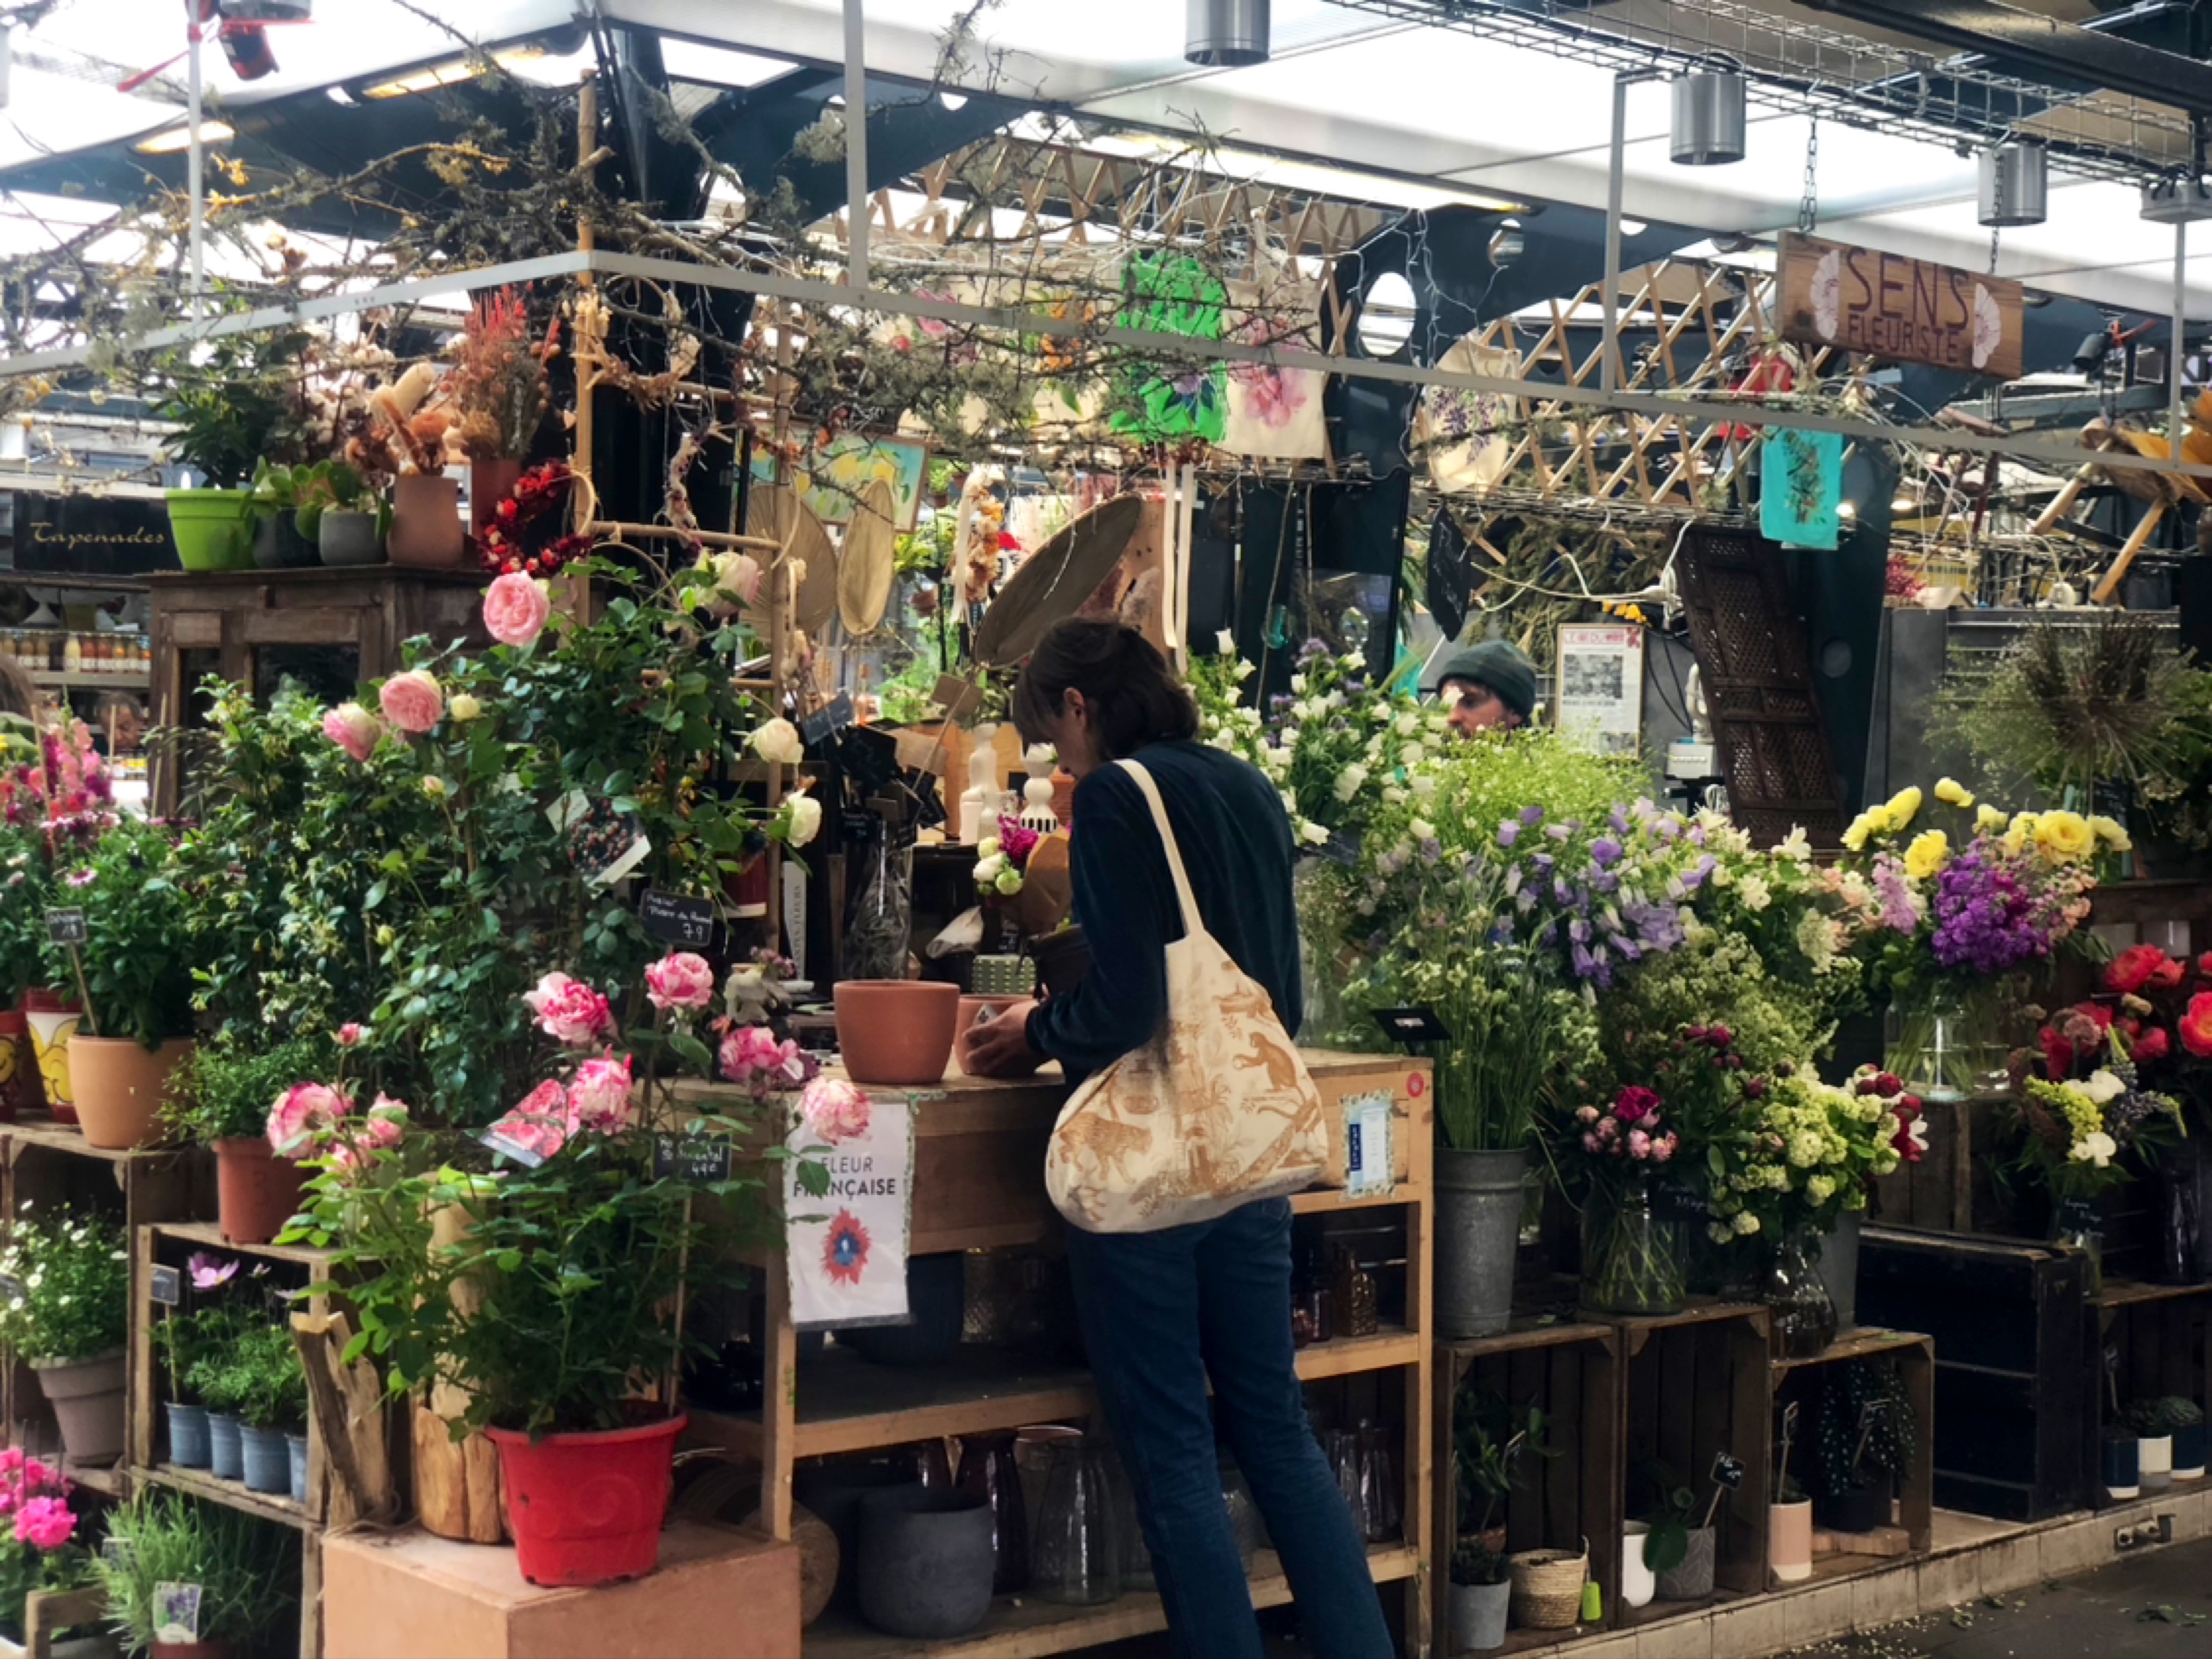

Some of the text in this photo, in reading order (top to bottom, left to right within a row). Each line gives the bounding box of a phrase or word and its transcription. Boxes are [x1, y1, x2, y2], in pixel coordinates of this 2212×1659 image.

[1846, 246, 1969, 330] SENS
[1848, 314, 1960, 363] FLEURISTE
[29, 522, 165, 550] Tapenades
[821, 1156, 874, 1174] FLEUR
[793, 1177, 896, 1201] FNÇAISE
